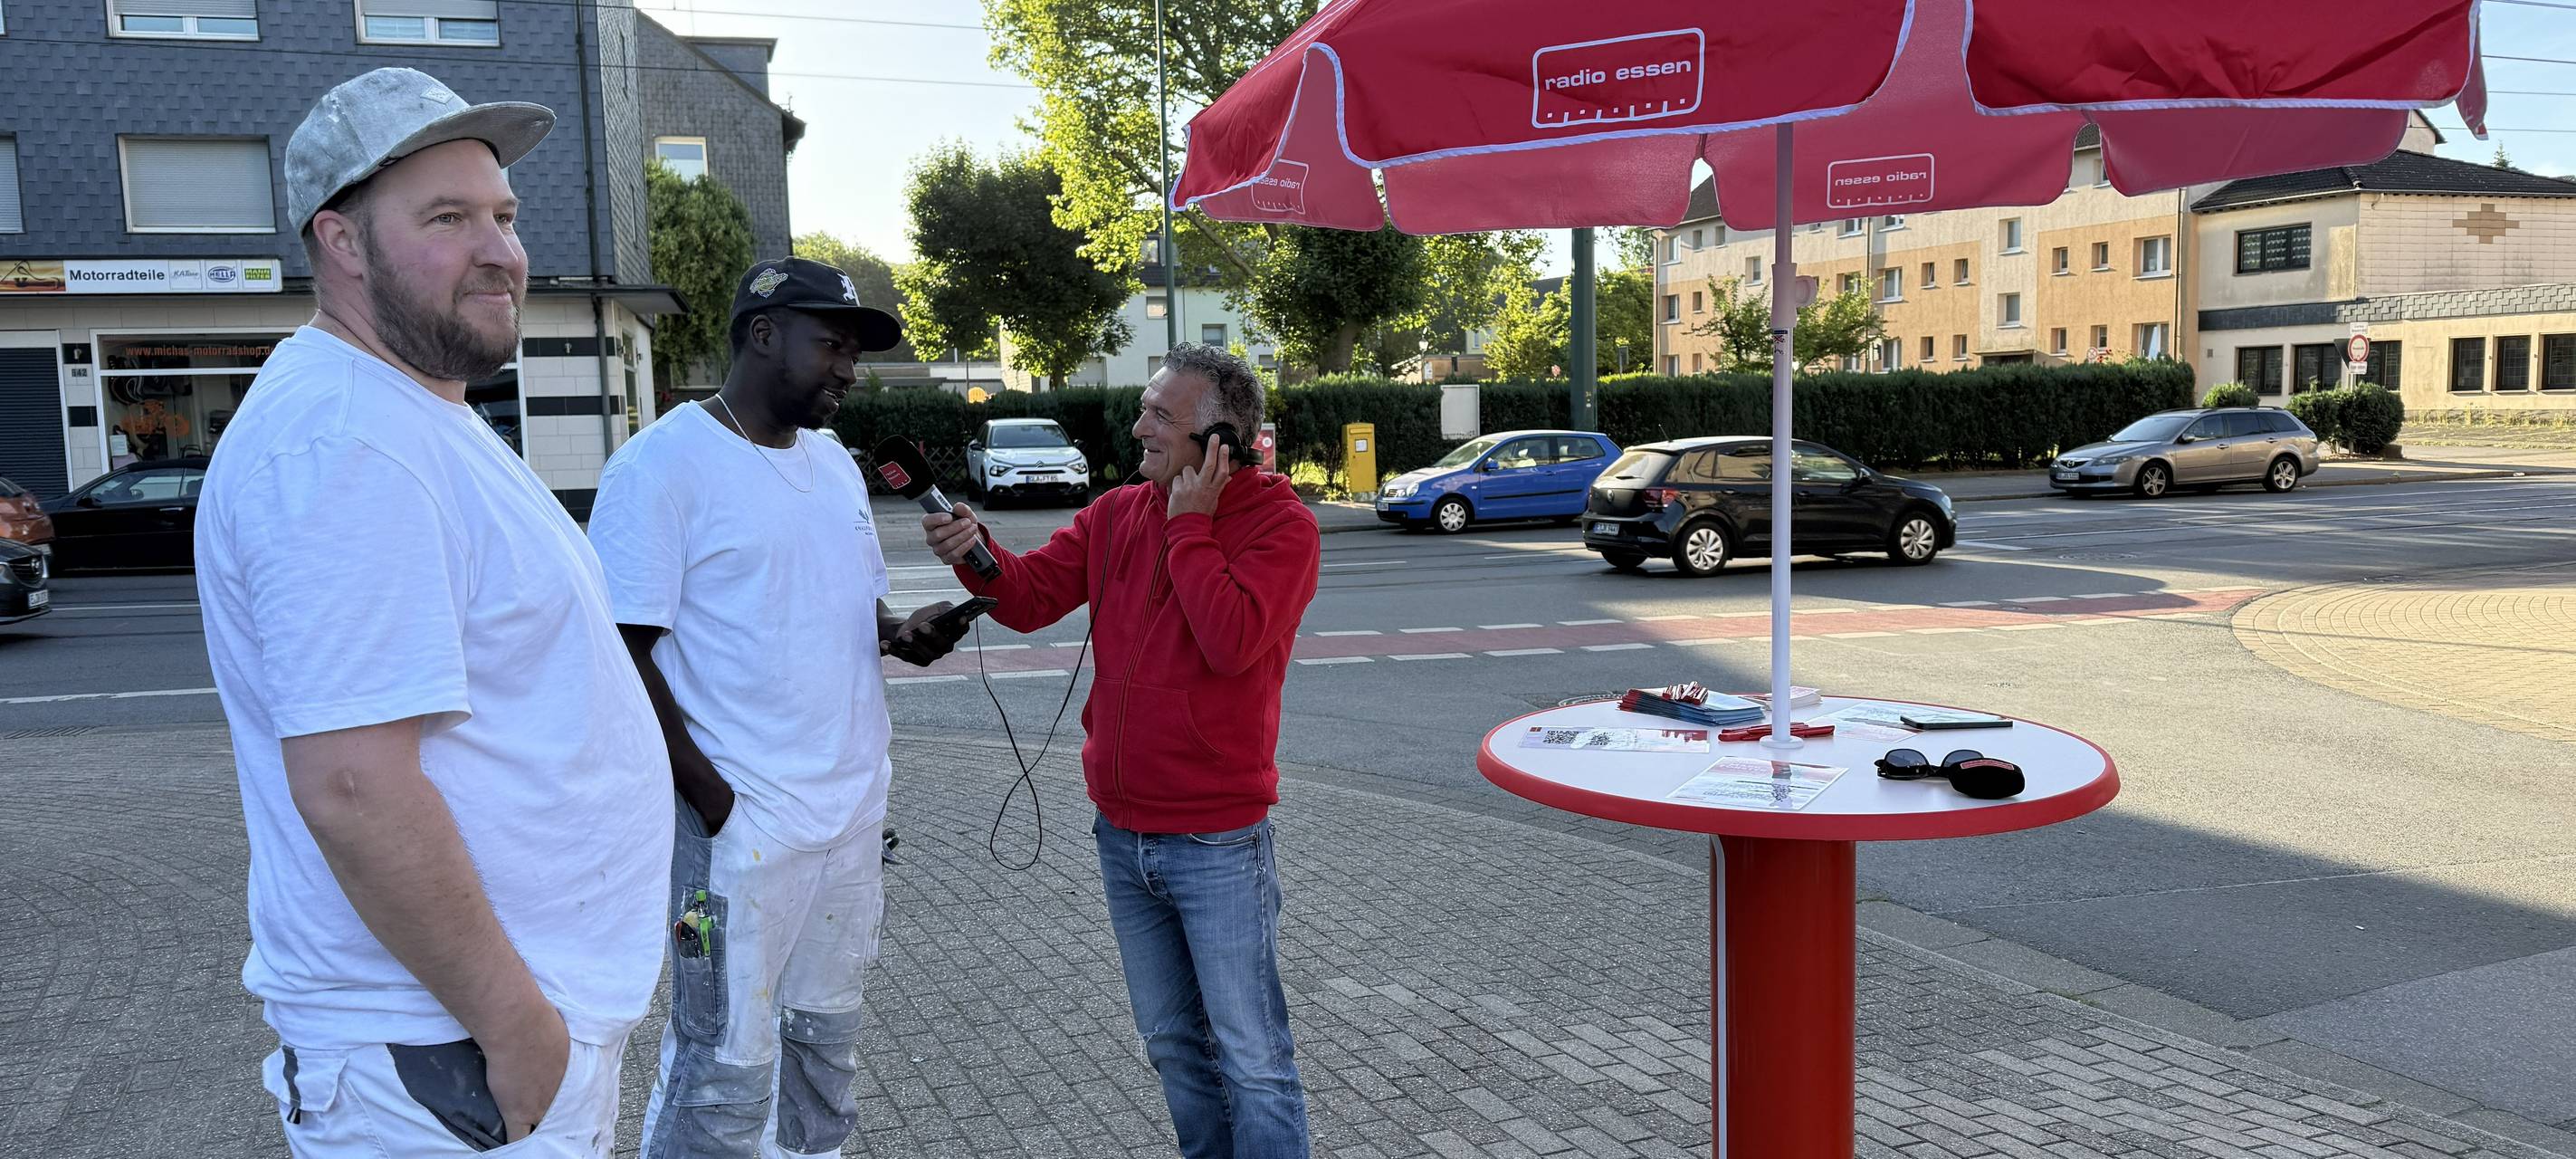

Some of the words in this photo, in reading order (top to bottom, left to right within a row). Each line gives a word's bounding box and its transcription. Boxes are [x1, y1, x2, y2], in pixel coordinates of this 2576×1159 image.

[1544, 68, 1607, 91] radio
[1615, 60, 1692, 81] essen
[69, 269, 166, 281] Motorradteile
[209, 270, 236, 278] HELLA
[125, 345, 274, 358] www.michas-motorradshop.d
